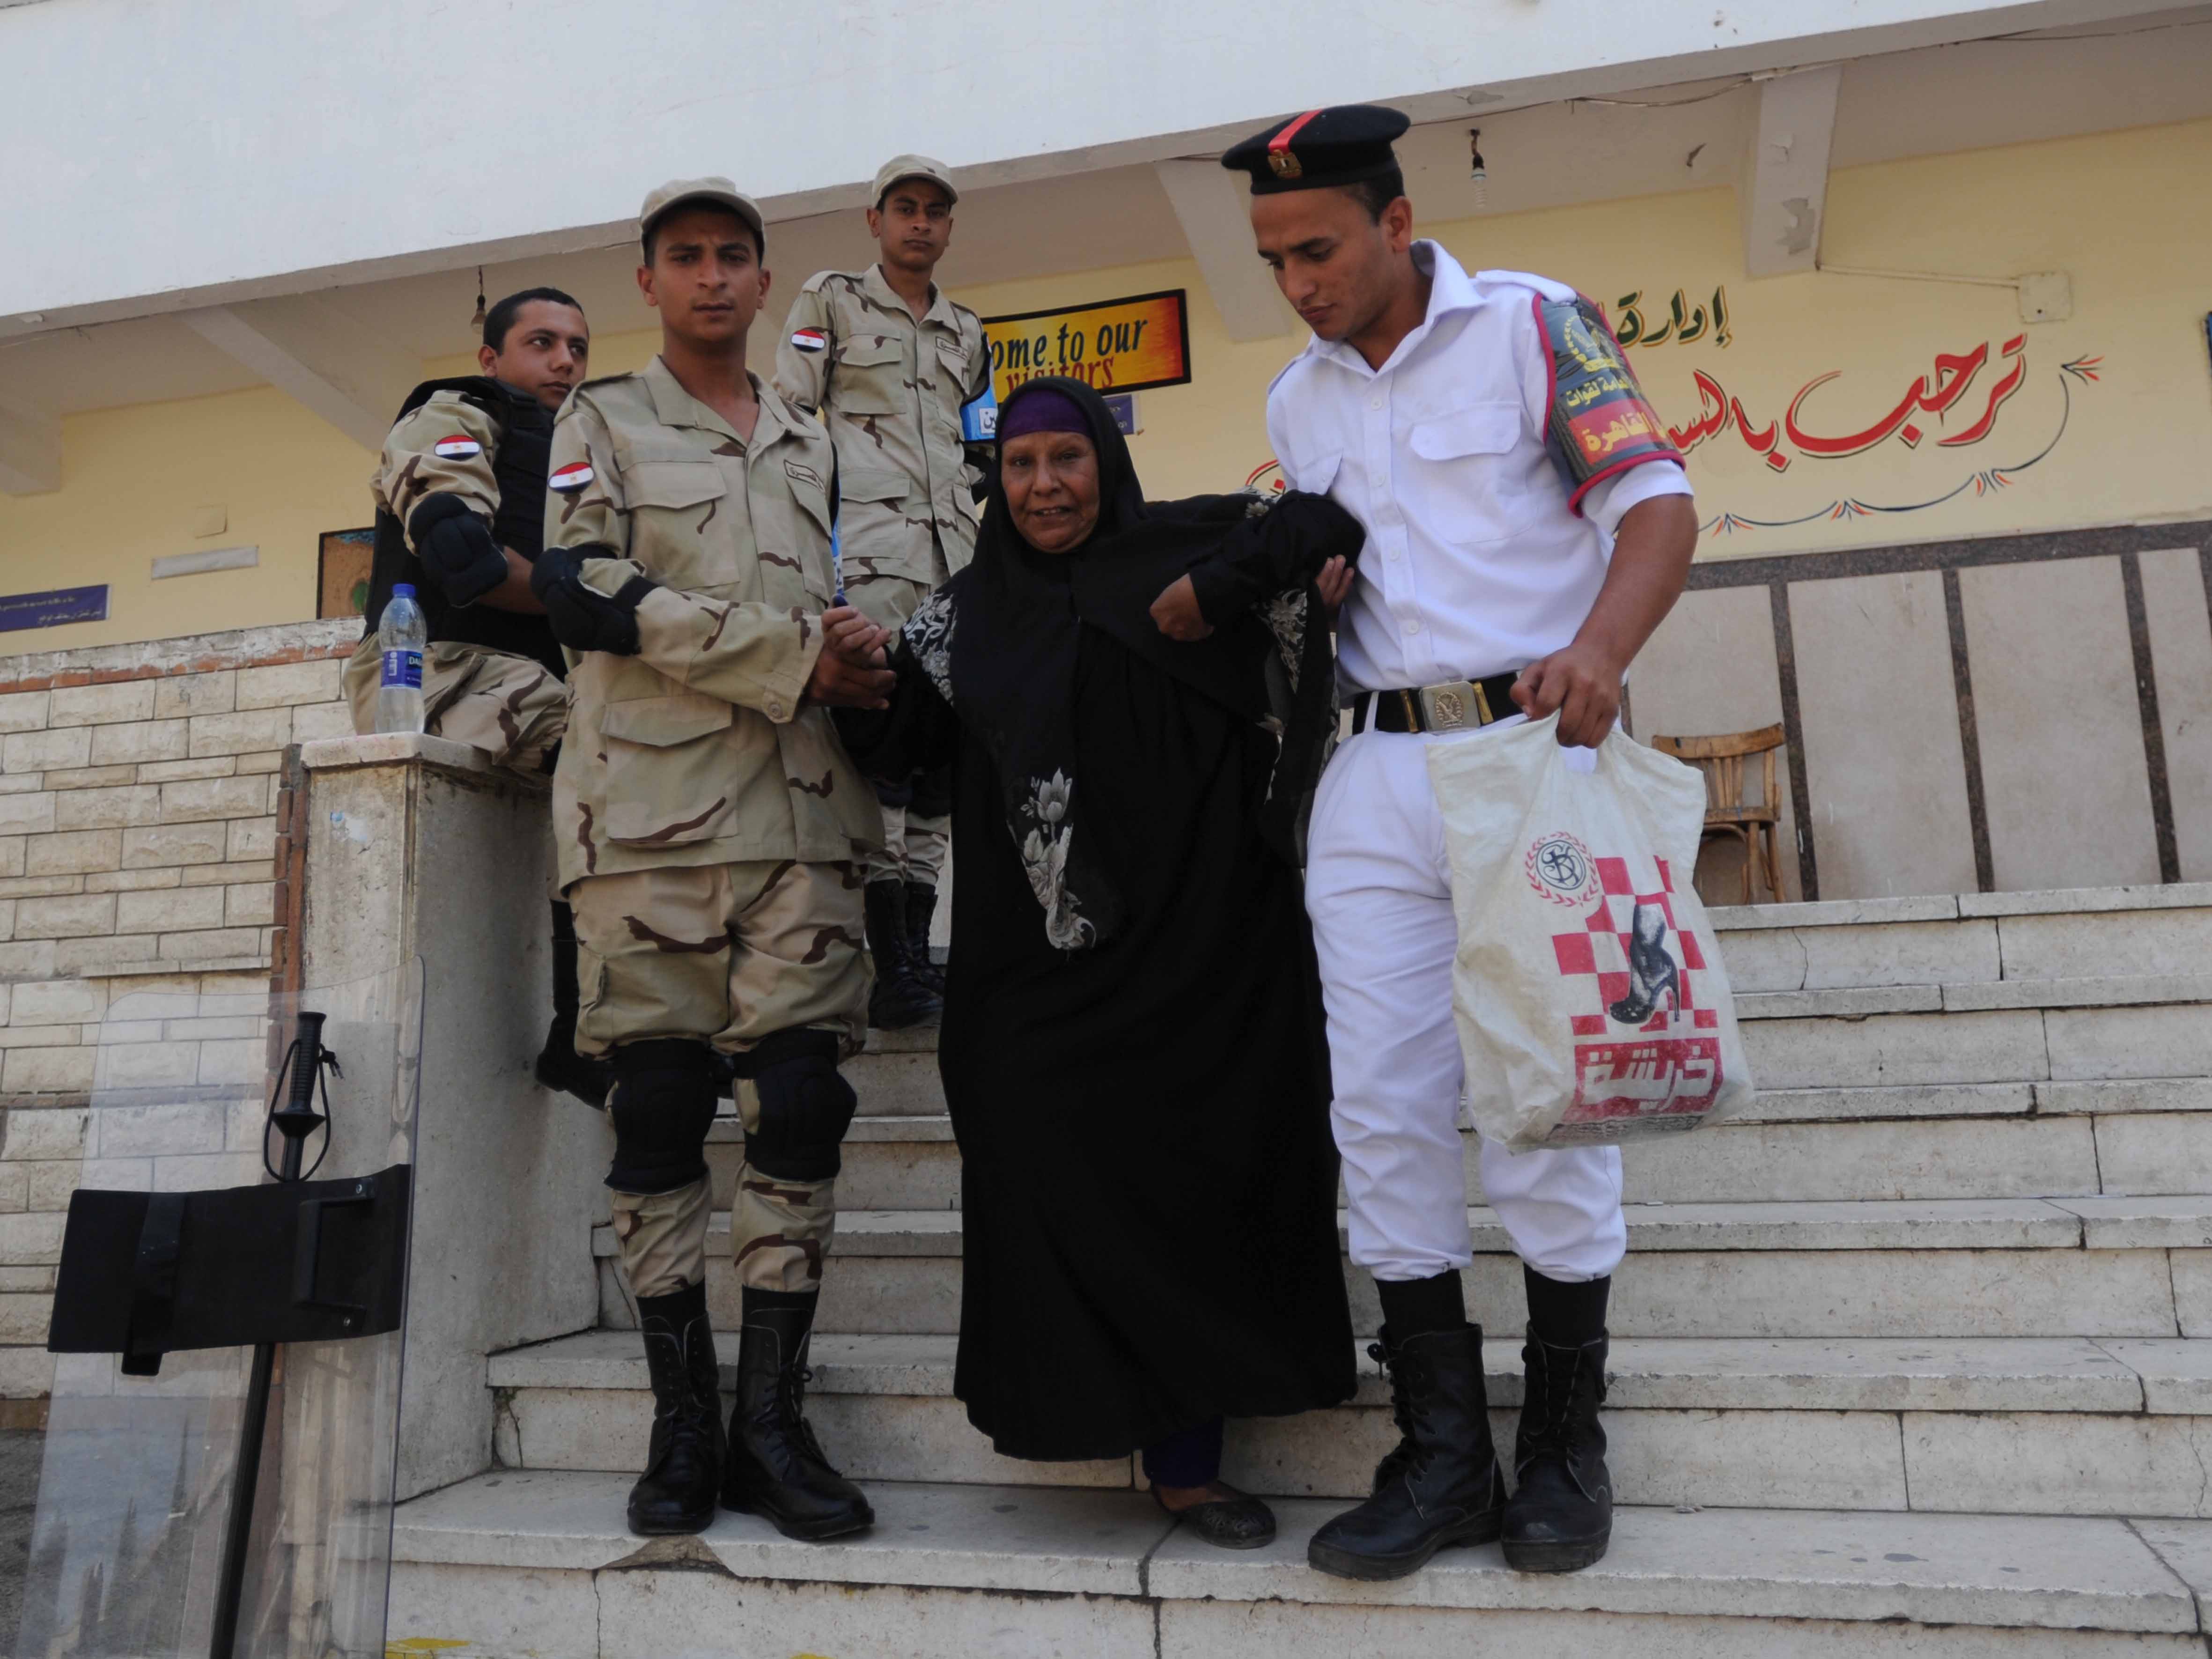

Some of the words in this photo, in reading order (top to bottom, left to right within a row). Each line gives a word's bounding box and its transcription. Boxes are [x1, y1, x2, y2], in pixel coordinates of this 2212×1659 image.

[1057, 323, 1084, 364] to
[1097, 319, 1148, 356] our
[1616, 284, 1732, 348] إدارة
[1006, 356, 1114, 392] vors
[1785, 333, 2027, 459] ترحب
[1667, 369, 1791, 472] بالس
